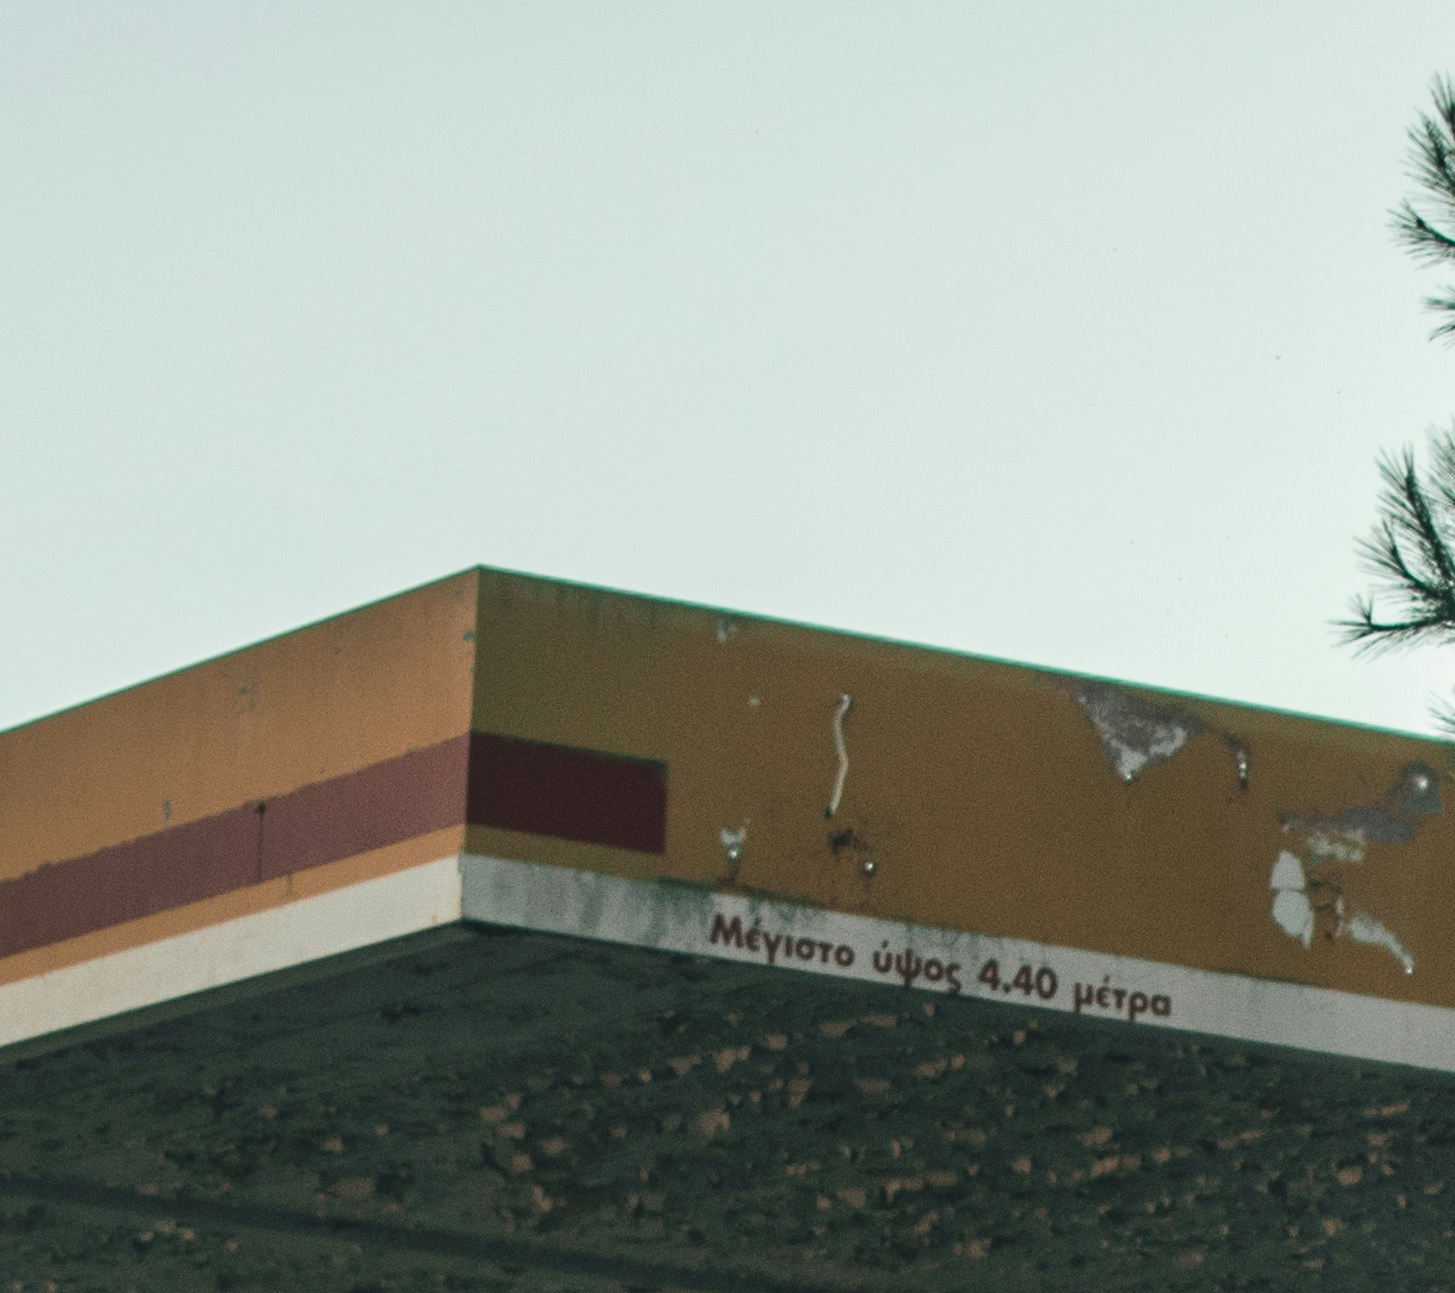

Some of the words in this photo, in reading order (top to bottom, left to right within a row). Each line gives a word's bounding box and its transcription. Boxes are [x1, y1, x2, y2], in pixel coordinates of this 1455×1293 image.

[709, 912, 855, 967] Μέγιστο
[873, 942, 962, 995] ύψος
[977, 958, 1058, 1001] 4.40
[1074, 976, 1173, 1023] μέτρα
